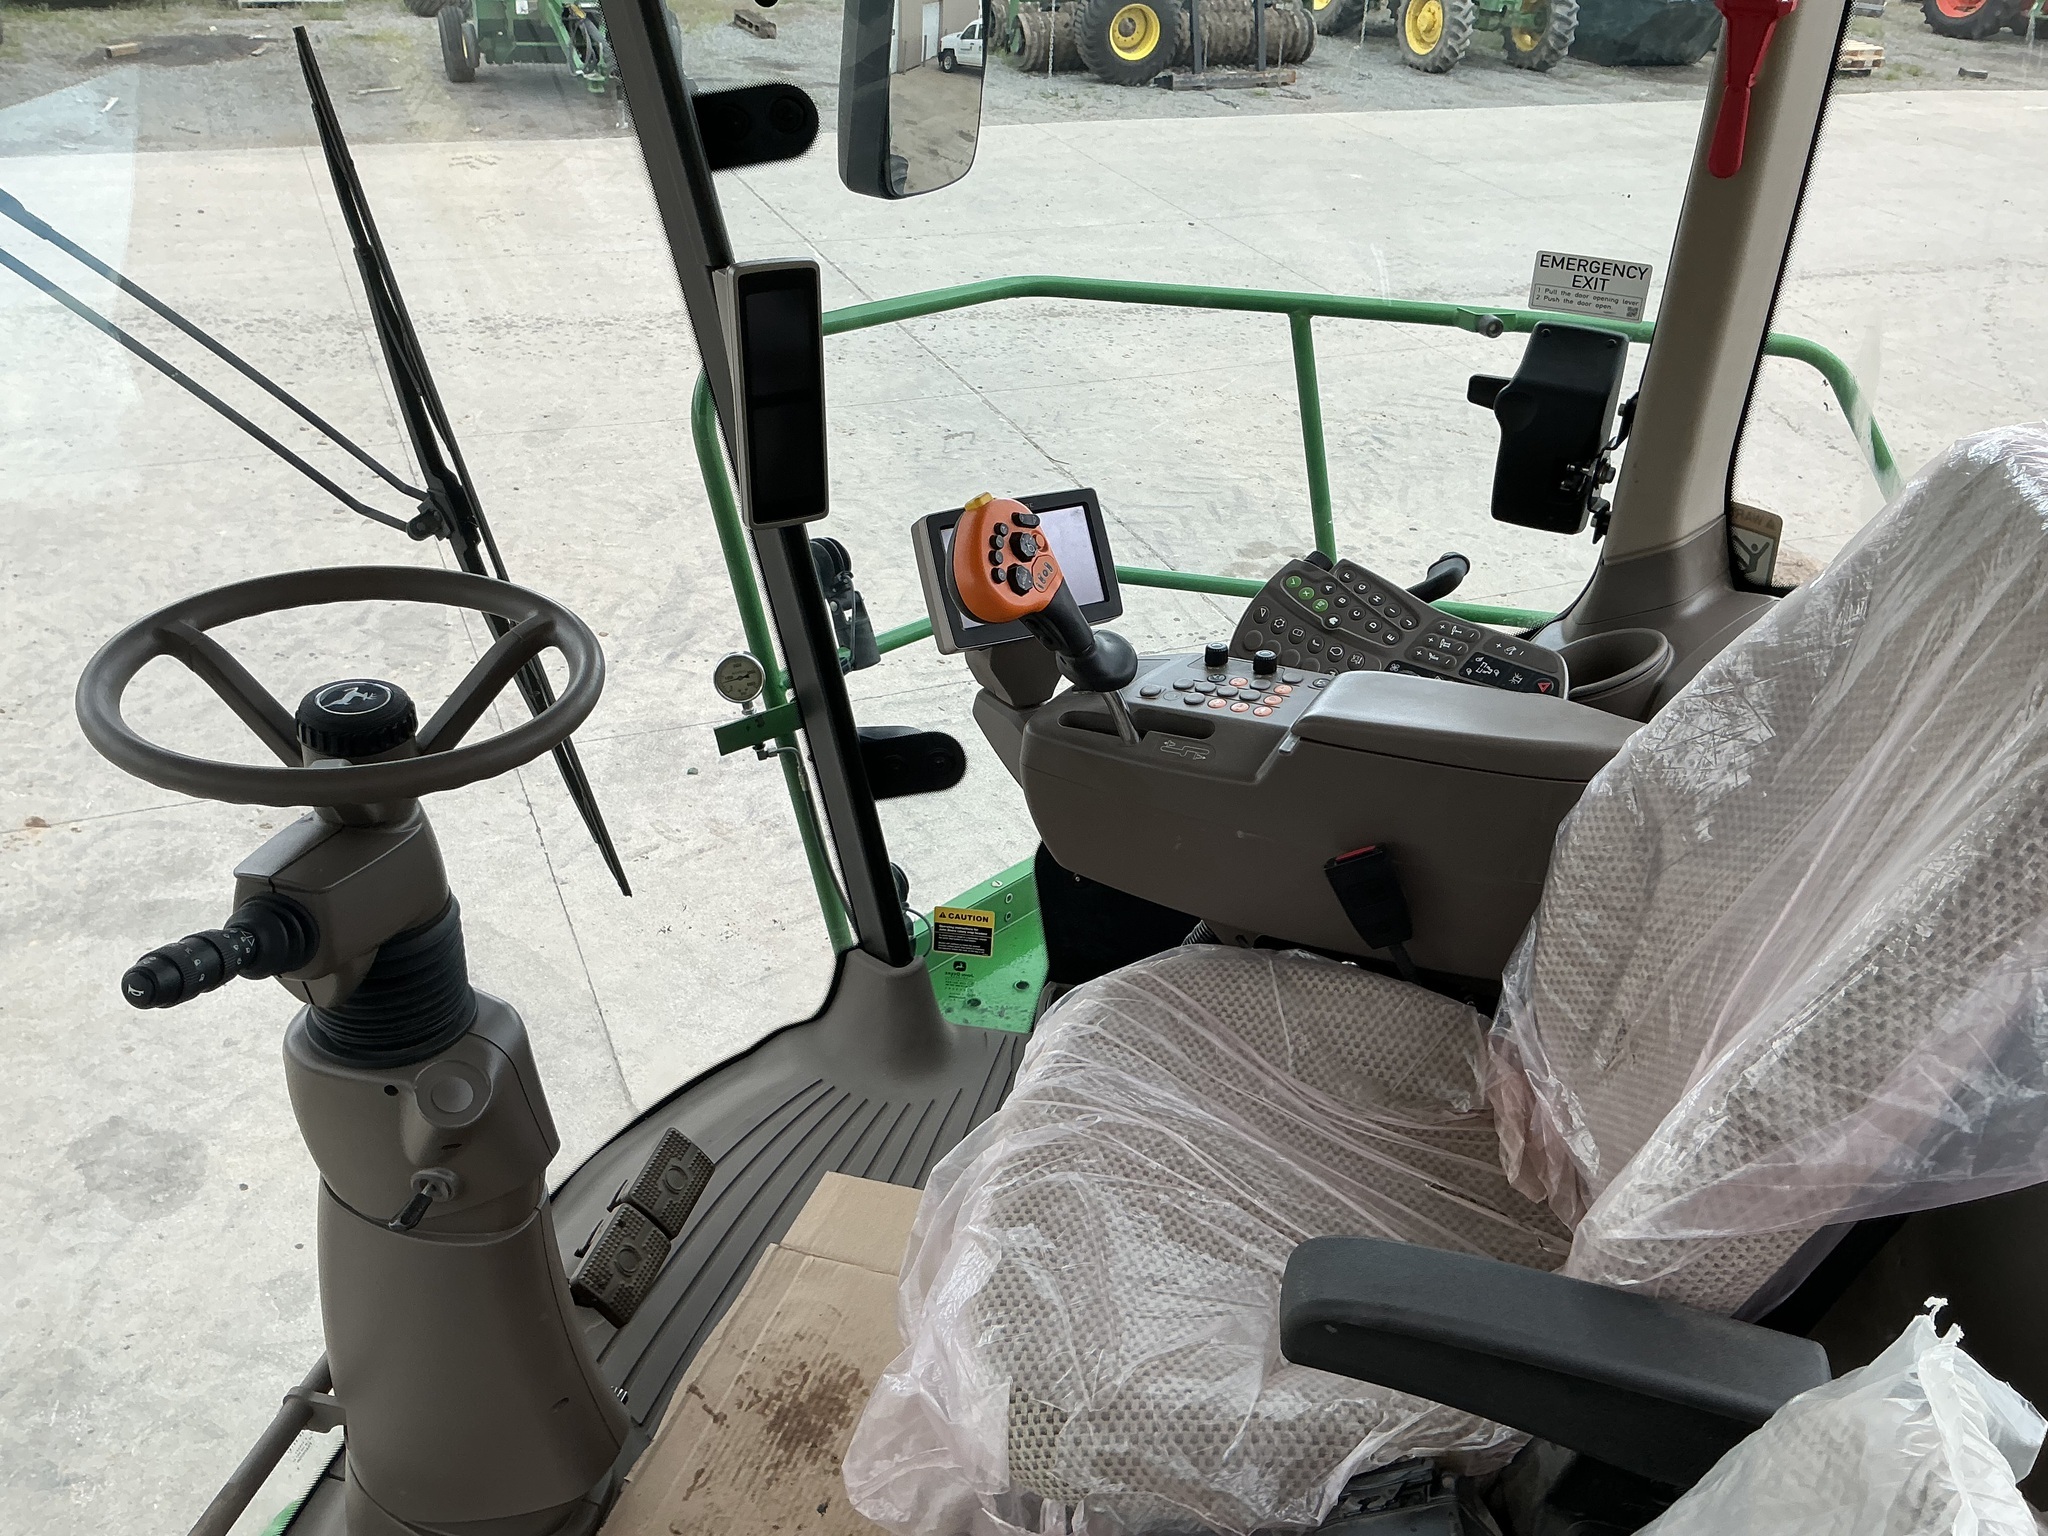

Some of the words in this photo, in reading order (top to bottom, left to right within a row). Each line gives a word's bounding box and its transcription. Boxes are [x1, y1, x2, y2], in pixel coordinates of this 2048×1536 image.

[1540, 254, 1649, 280] EMERGENCY
[1572, 274, 1610, 291] EXIT
[1543, 295, 1560, 303] Push
[1577, 299, 1592, 307] door
[1592, 295, 1619, 304] opening
[1386, 633, 1395, 641] E
[948, 912, 989, 923] CAUTION
